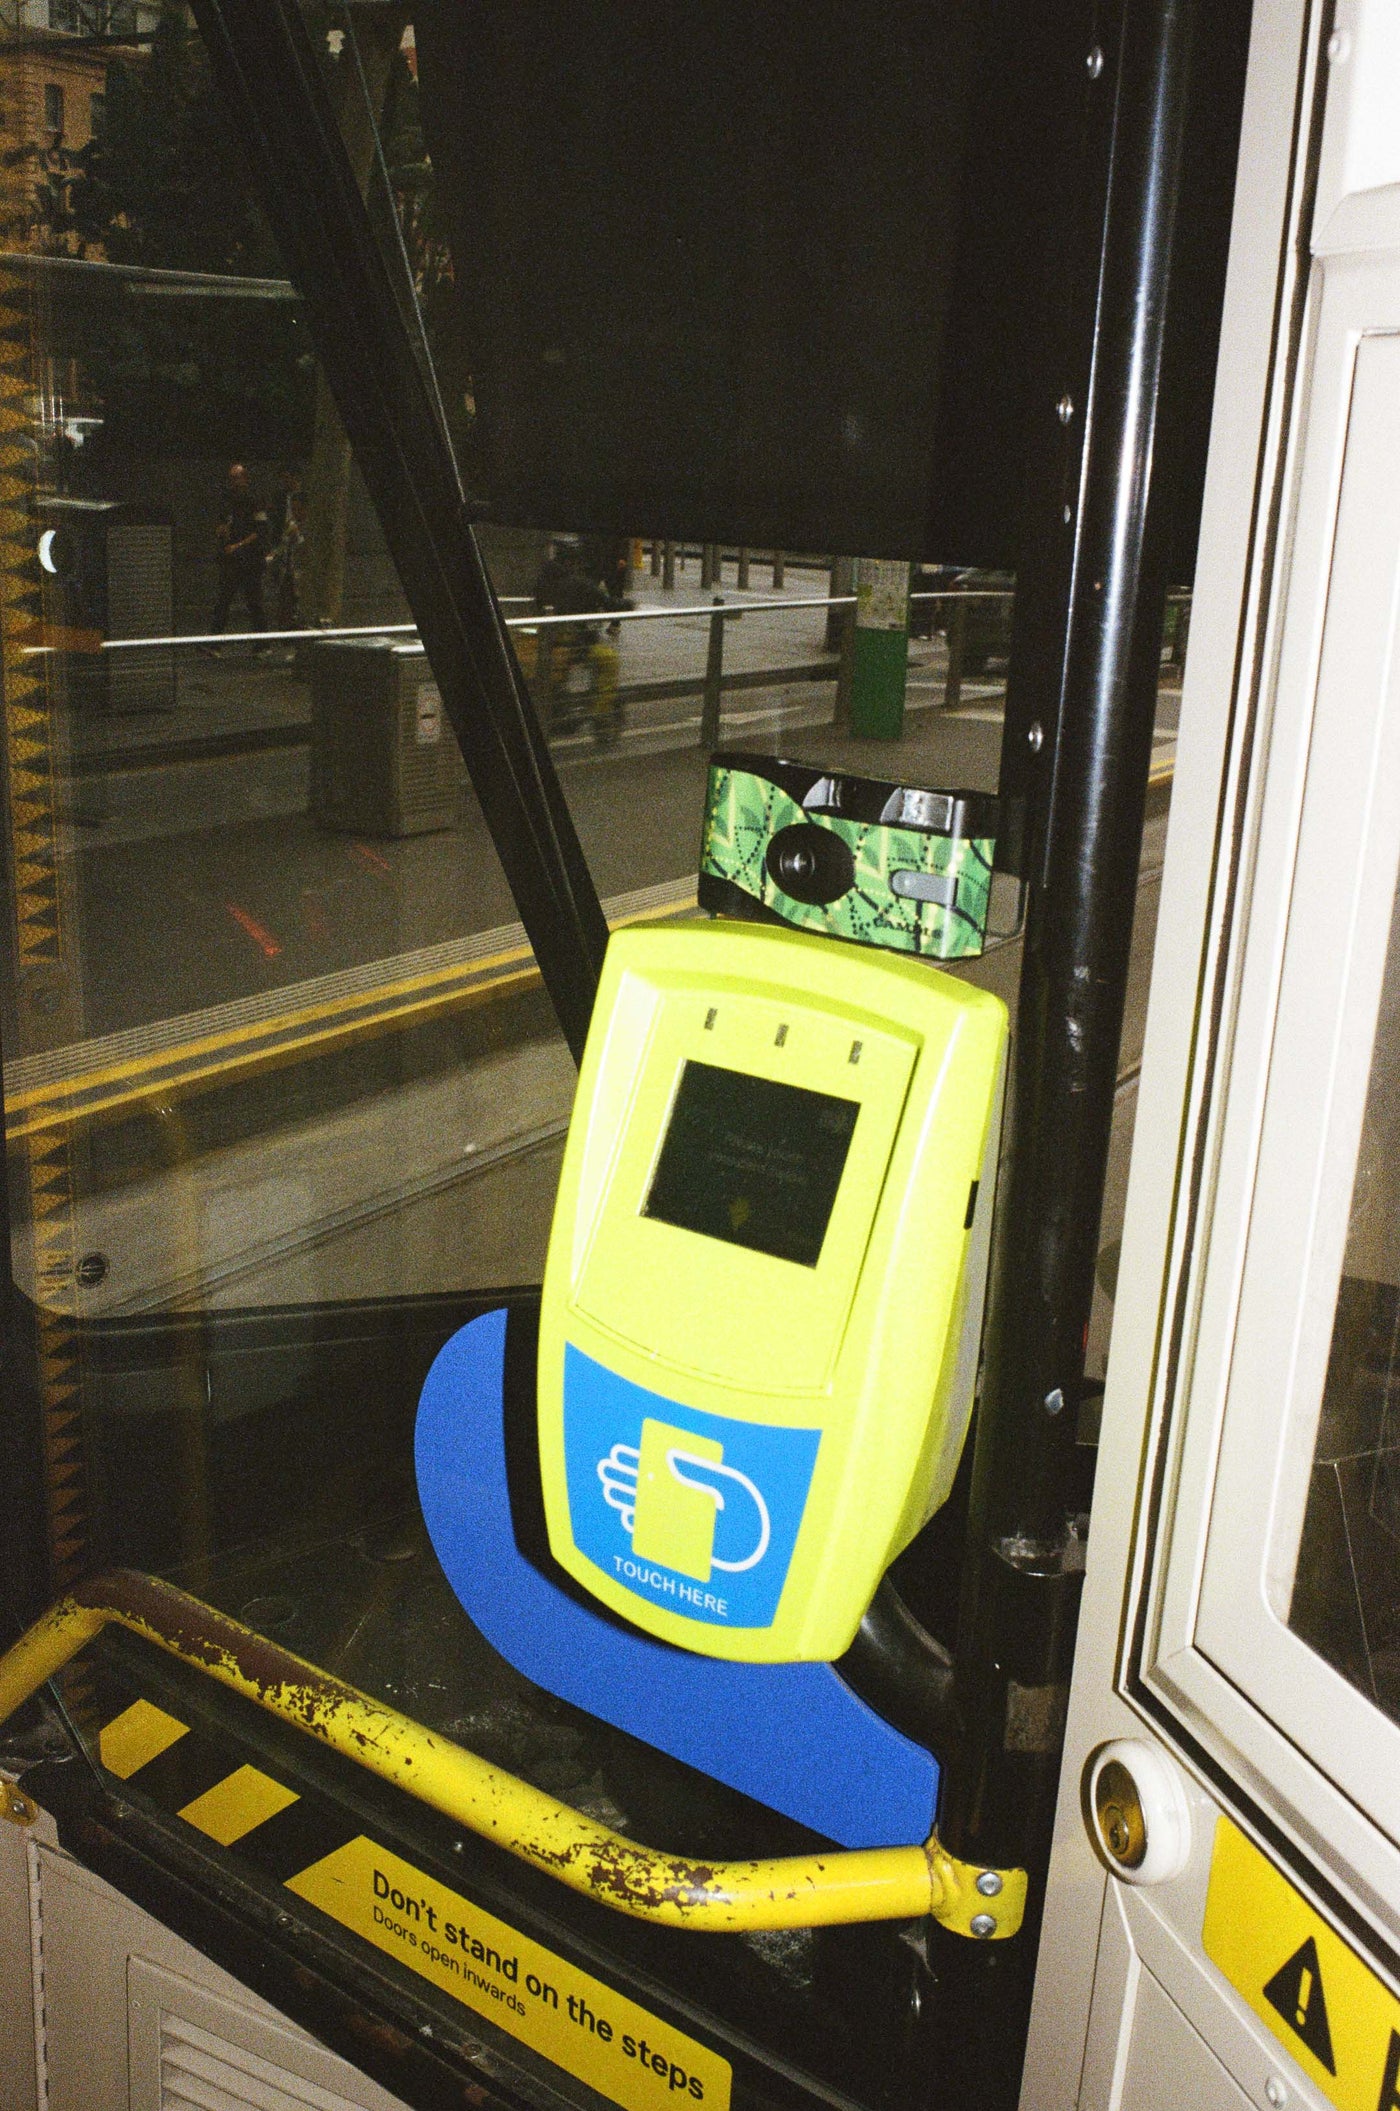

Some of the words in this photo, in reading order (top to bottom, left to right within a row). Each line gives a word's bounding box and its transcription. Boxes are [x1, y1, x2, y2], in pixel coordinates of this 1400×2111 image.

[613, 1555, 676, 1595] TOUCH
[678, 1582, 728, 1617] HERE
[373, 1907, 417, 1947] Doors
[421, 1940, 460, 1975] open
[463, 1963, 527, 2017] inwards
[373, 1868, 438, 1933] Don’t
[444, 1921, 518, 1983] stand
[525, 1974, 559, 2009] on
[566, 1994, 614, 2043] the
[621, 2034, 705, 2101] steps
